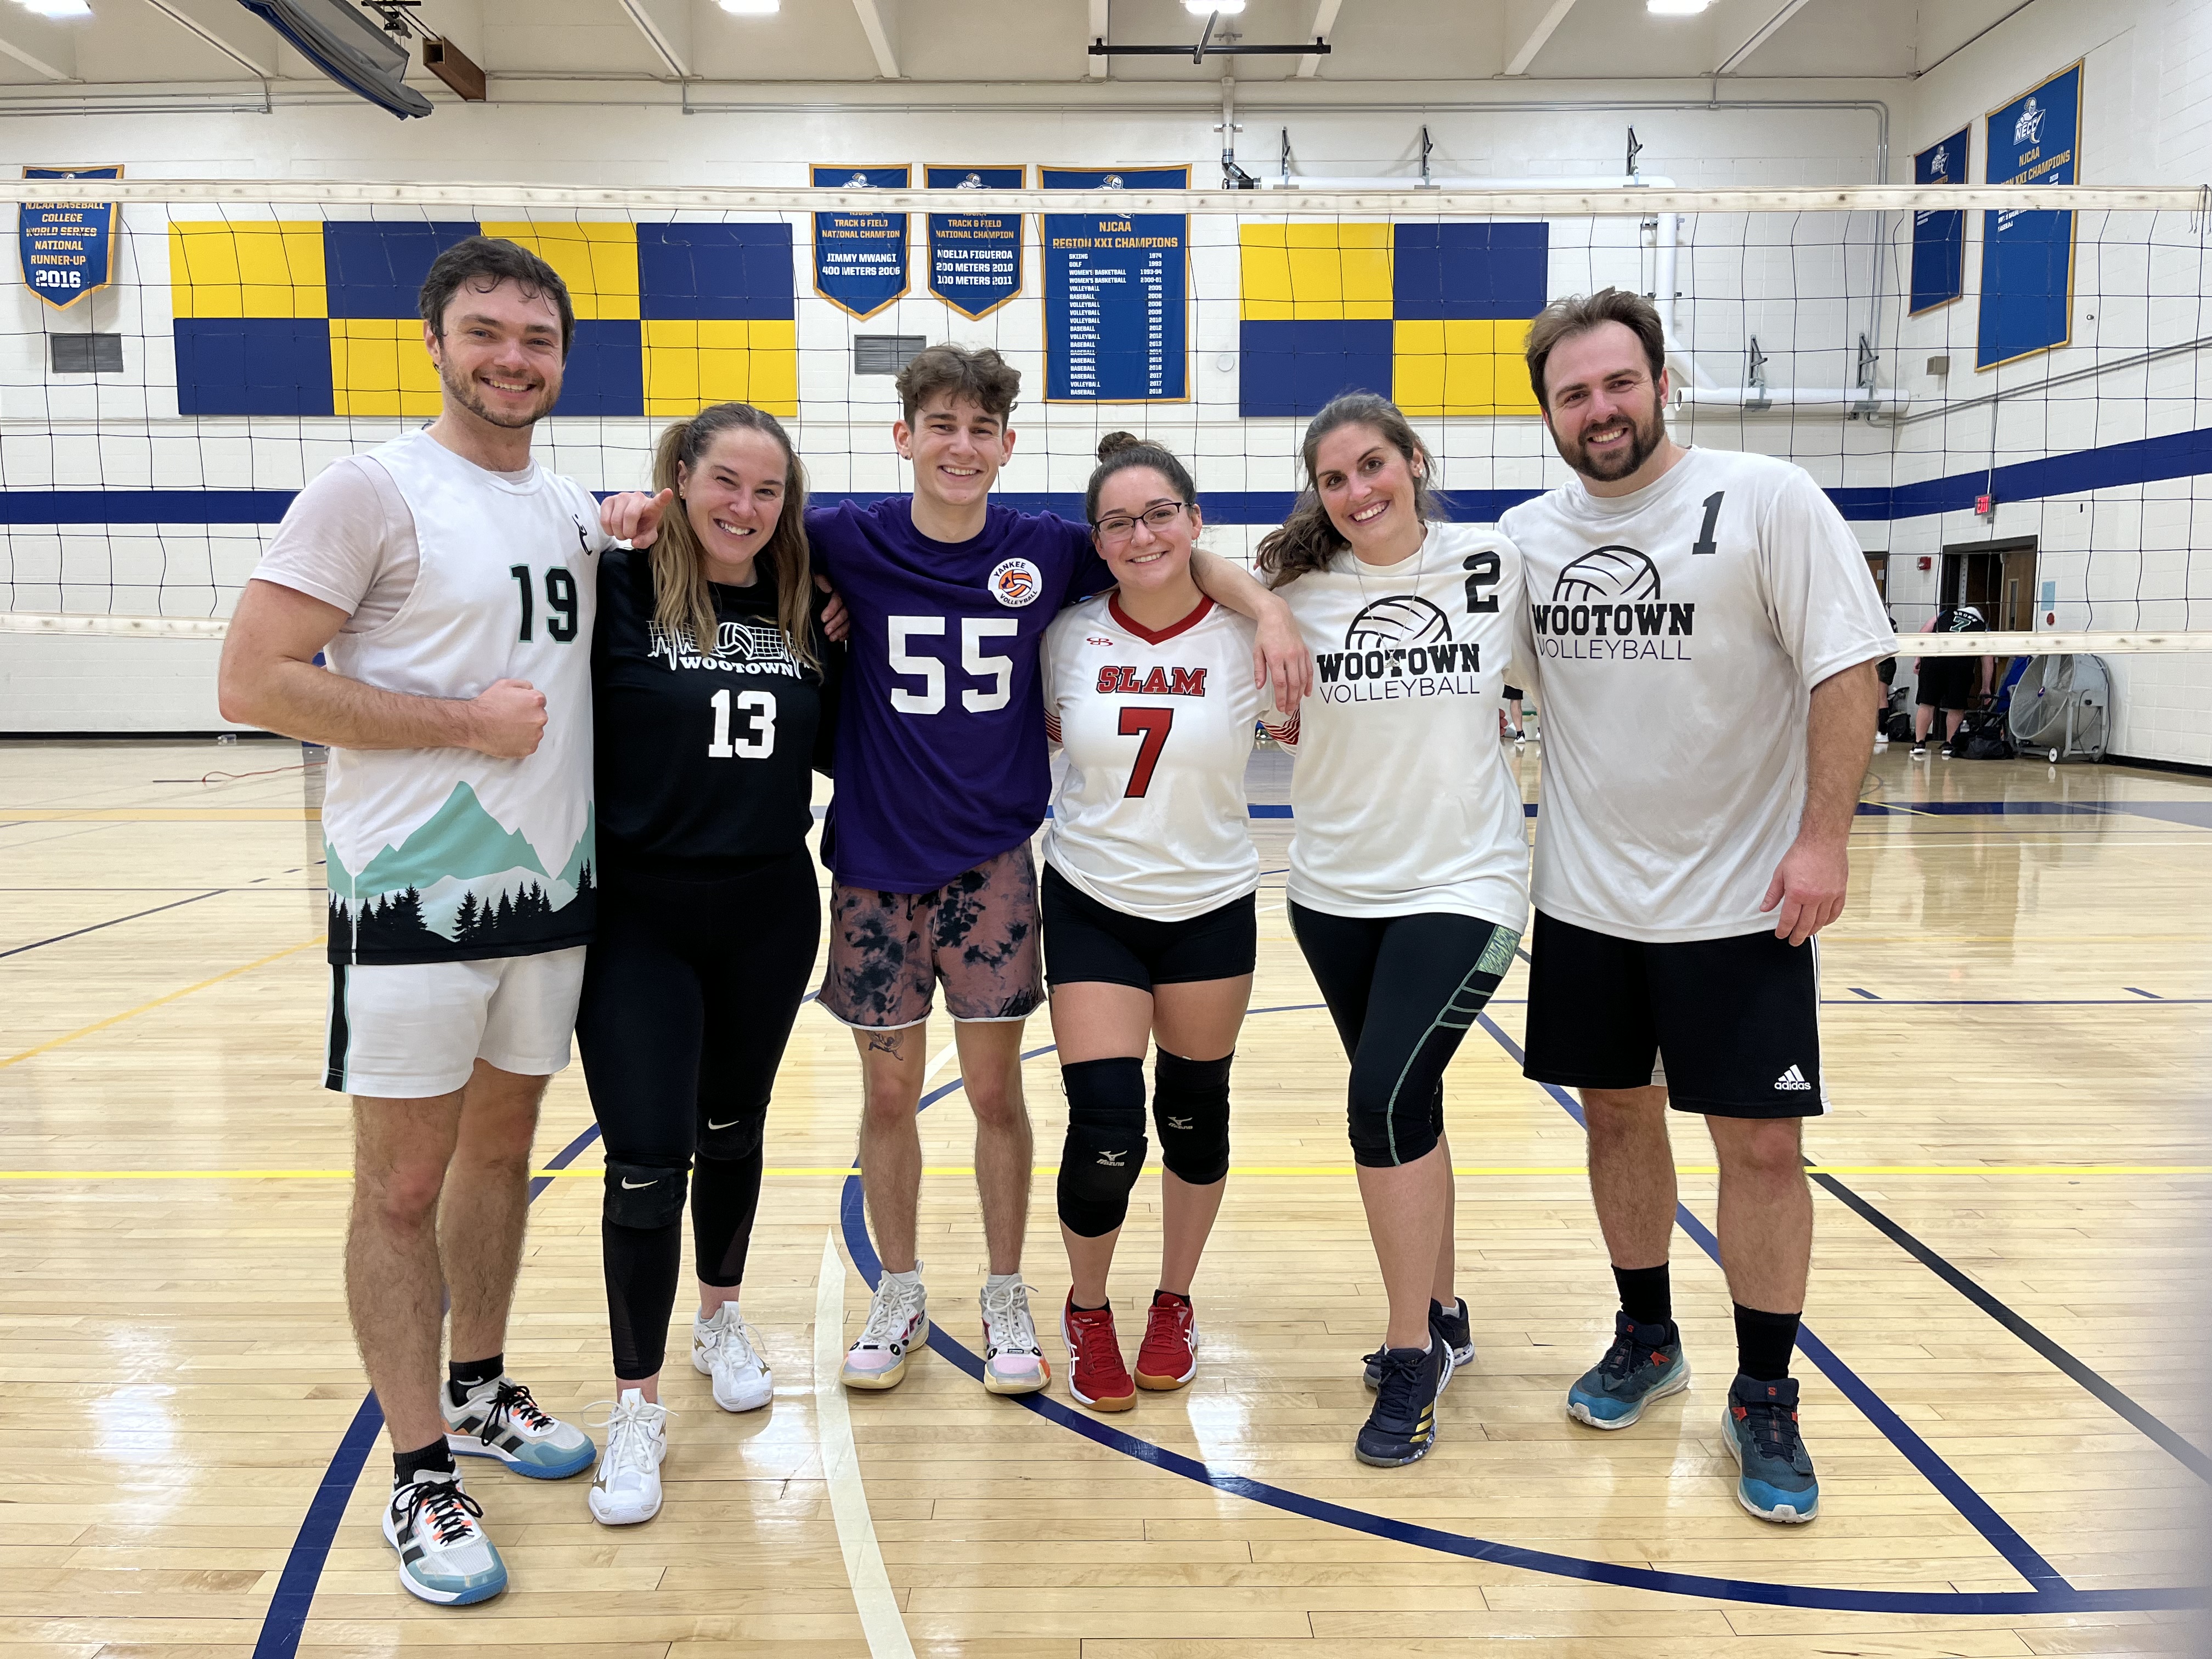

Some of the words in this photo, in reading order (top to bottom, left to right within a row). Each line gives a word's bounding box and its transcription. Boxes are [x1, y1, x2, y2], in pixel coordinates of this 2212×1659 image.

[2016, 118, 2037, 140] NECC
[2019, 146, 2040, 167] NJCAA
[2016, 171, 2027, 184] XXI
[2028, 150, 2070, 180] CHAMPIONS
[42, 213, 83, 222] COLLEGE
[26, 227, 58, 237] WORLD
[60, 227, 97, 236] SERIES
[822, 230, 859, 238] NATIONAL
[860, 230, 900, 238] CHAMPION
[1099, 222, 1131, 232] NJCAA
[35, 240, 83, 250] NATIONAL
[1053, 238, 1092, 249] REGION
[1094, 238, 1113, 248] XXI
[1115, 237, 1178, 248] CHAMPIONS
[31, 255, 86, 265] RUNNER-UP
[827, 253, 857, 262] JIMMY
[859, 253, 896, 262] MWANGI
[937, 249, 968, 259] NOELIA
[970, 250, 1013, 259] FIGUEROA
[822, 266, 839, 275] 400
[842, 267, 877, 275] METERS
[878, 267, 900, 275] 2006
[936, 262, 953, 271] 200
[955, 263, 990, 272] METERS
[992, 263, 1013, 272] 2010
[36, 270, 81, 287] 2016
[937, 275, 953, 284] 100
[956, 276, 990, 285] METERS
[992, 276, 1012, 285] 2011
[1692, 490, 1725, 555] 1
[994, 561, 1026, 577] YANKEE
[1462, 550, 1500, 613] 2
[509, 563, 579, 644] 19
[1000, 590, 1037, 605] VOLLEYBALL
[1532, 603, 1695, 635] WOOTOWN
[1538, 639, 1692, 660] VOLLEYBALL
[679, 656, 794, 677] WOOTOWN
[888, 616, 1018, 714] 55
[1317, 643, 1480, 683] WOOTOWN
[1096, 665, 1207, 697] SLAM
[1319, 675, 1480, 704] VOLLEYBALL
[708, 689, 776, 759] 13
[1118, 707, 1175, 798] 7
[1774, 1081, 1811, 1091] adidas
